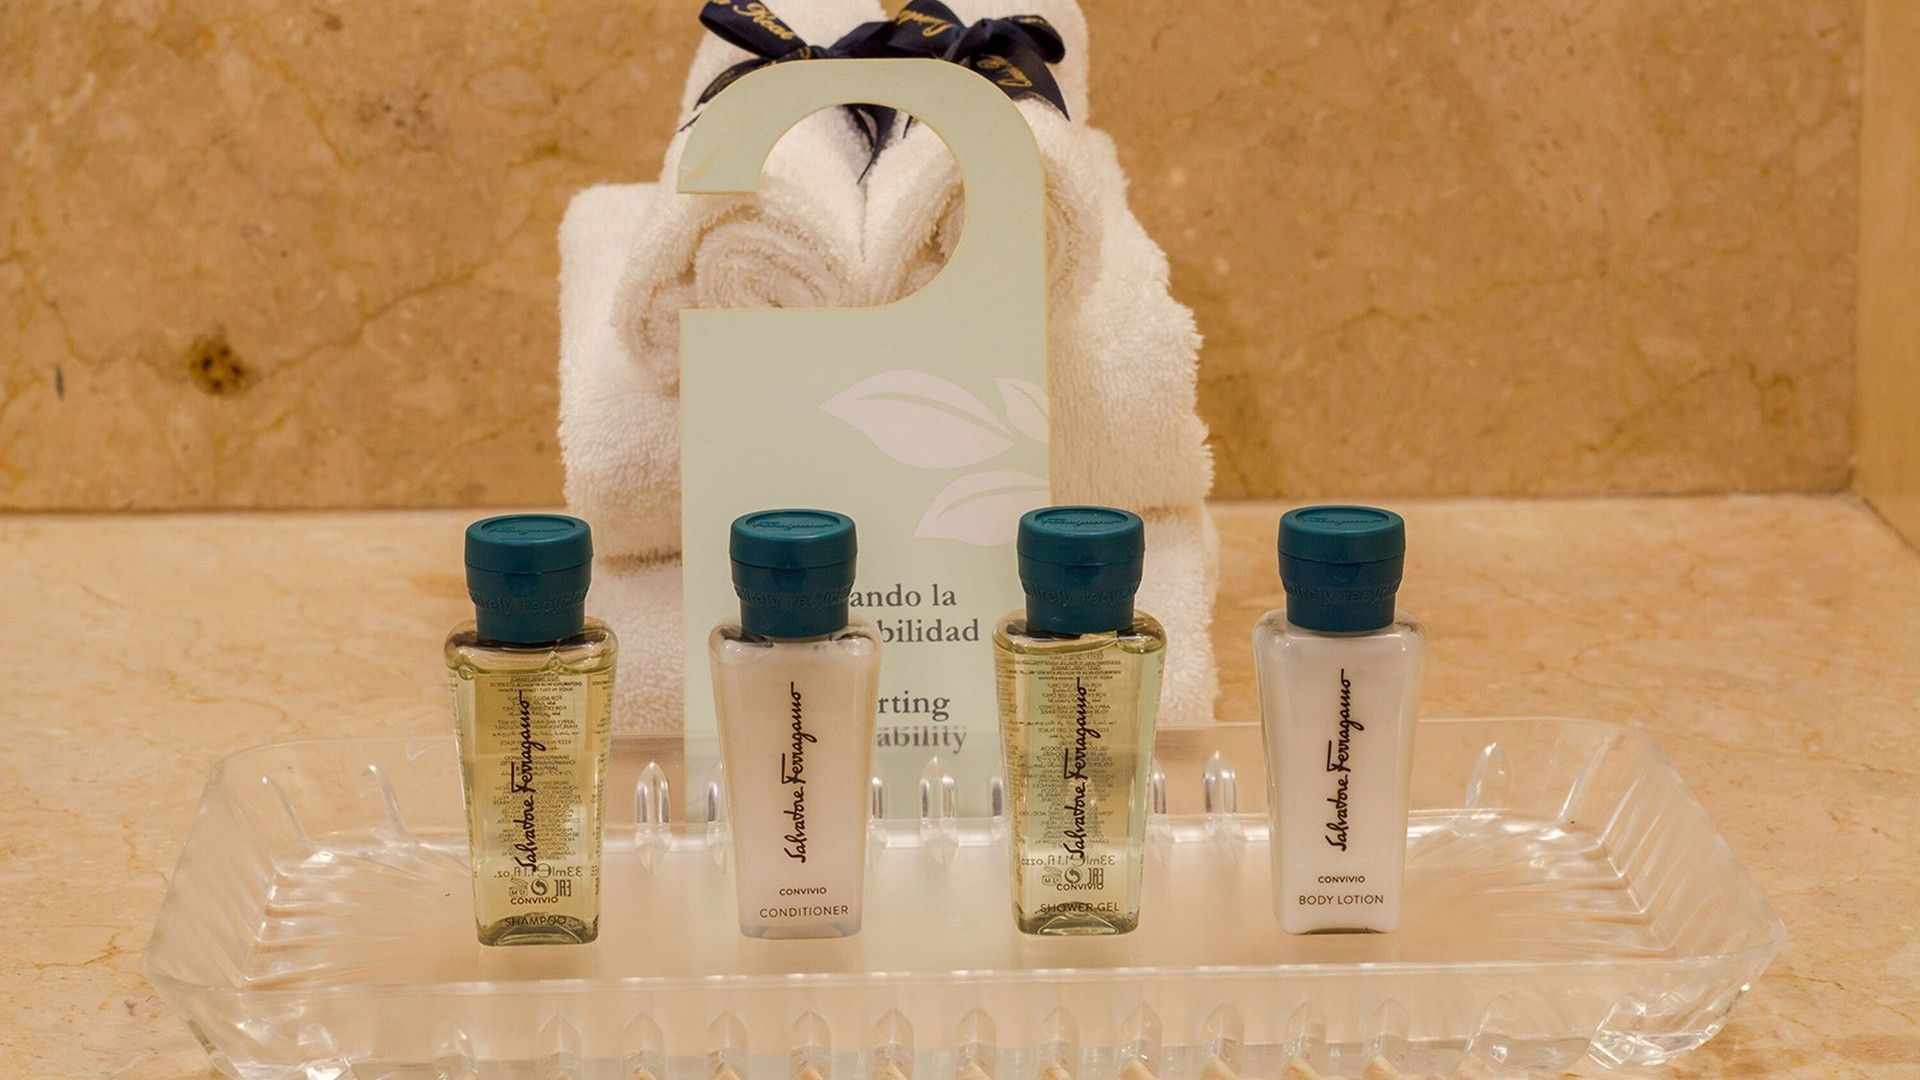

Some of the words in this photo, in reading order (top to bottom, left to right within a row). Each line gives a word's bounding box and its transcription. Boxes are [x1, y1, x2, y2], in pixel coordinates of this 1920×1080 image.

[850, 583, 922, 607] ando
[932, 583, 957, 607] la
[877, 618, 980, 643] bilidad
[878, 690, 950, 722] rting
[781, 681, 818, 784] Ferragamo
[1064, 677, 1102, 780] Ferragamo
[1326, 668, 1365, 772] Ferragamo
[511, 689, 547, 793] Ferragamo
[876, 724, 967, 754] ability
[783, 787, 807, 863] Salvatore
[1063, 782, 1087, 860] Salvatore
[1325, 774, 1349, 851] Salvatore
[513, 795, 538, 872] Salvatore
[779, 887, 827, 896] CONVIVIO
[1056, 882, 1105, 891] CONVIVIO
[1317, 875, 1366, 884] CONVIVIO
[510, 896, 559, 906] CONVIVIO
[759, 904, 849, 918] CONDITIONER
[1040, 903, 1094, 914] SHOWER
[1096, 902, 1121, 912] GEL
[1299, 894, 1334, 906] BODY
[1337, 894, 1384, 905] LOTION
[504, 915, 567, 928] SHAMPOO
